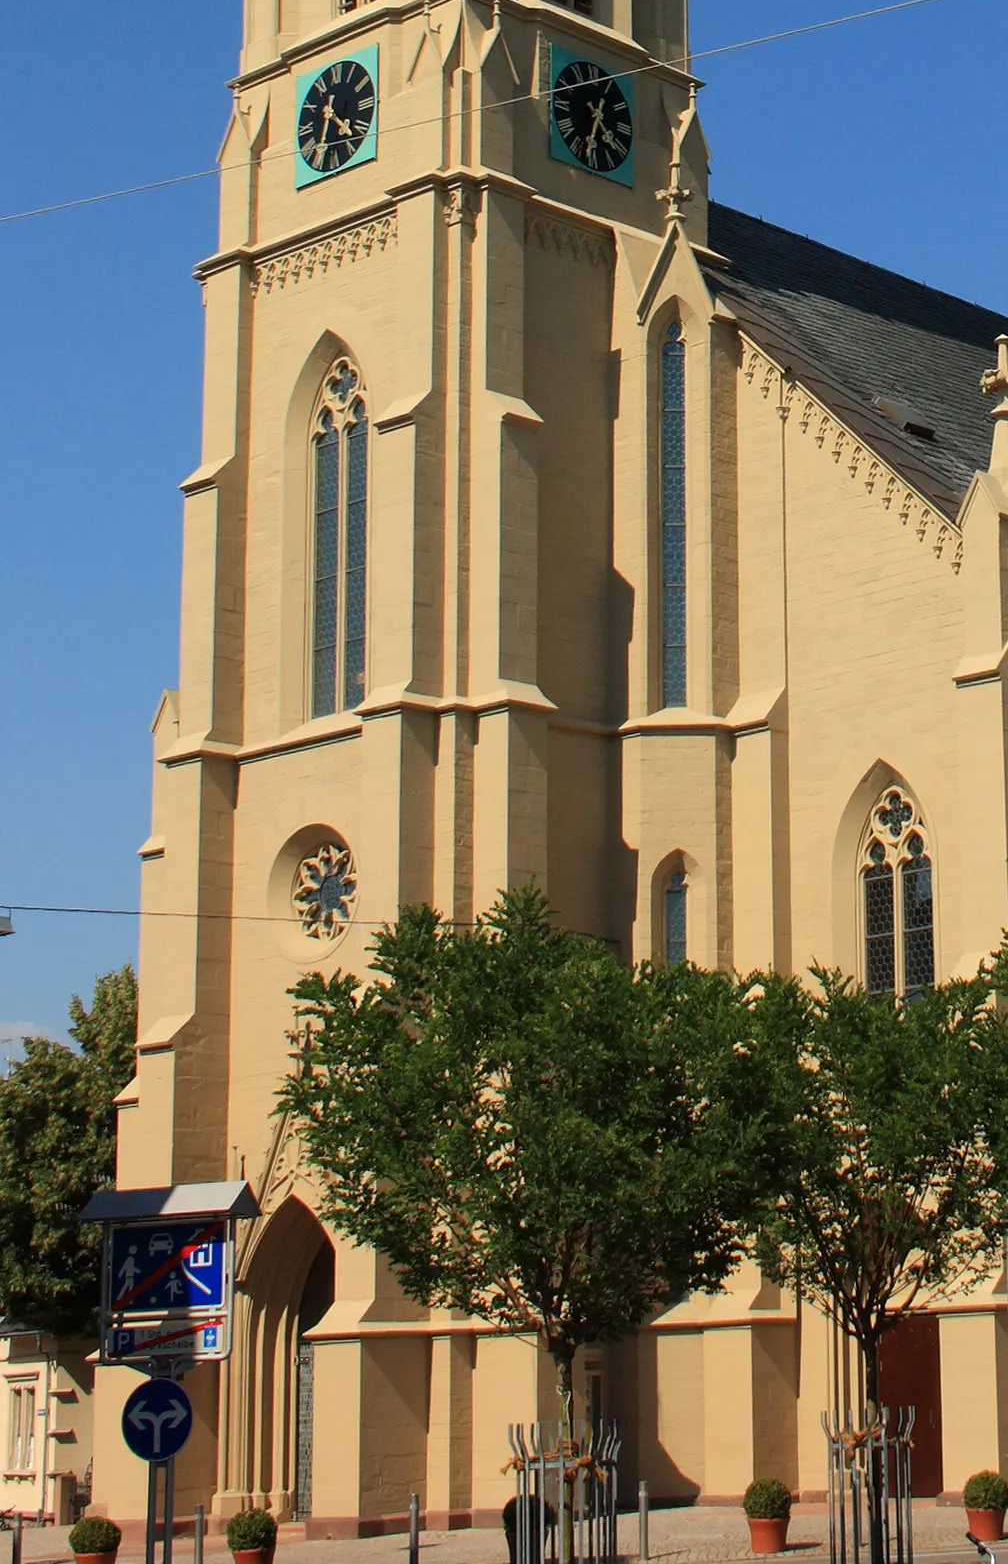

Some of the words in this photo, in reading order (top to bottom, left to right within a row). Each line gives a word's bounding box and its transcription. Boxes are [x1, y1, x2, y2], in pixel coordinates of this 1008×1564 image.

[346, 63, 356, 83] I
[604, 80, 613, 94] I
[303, 100, 317, 113] X
[358, 96, 374, 111] III
[613, 101, 627, 111] II
[617, 122, 631, 136] III
[118, 1332, 129, 1350] P
